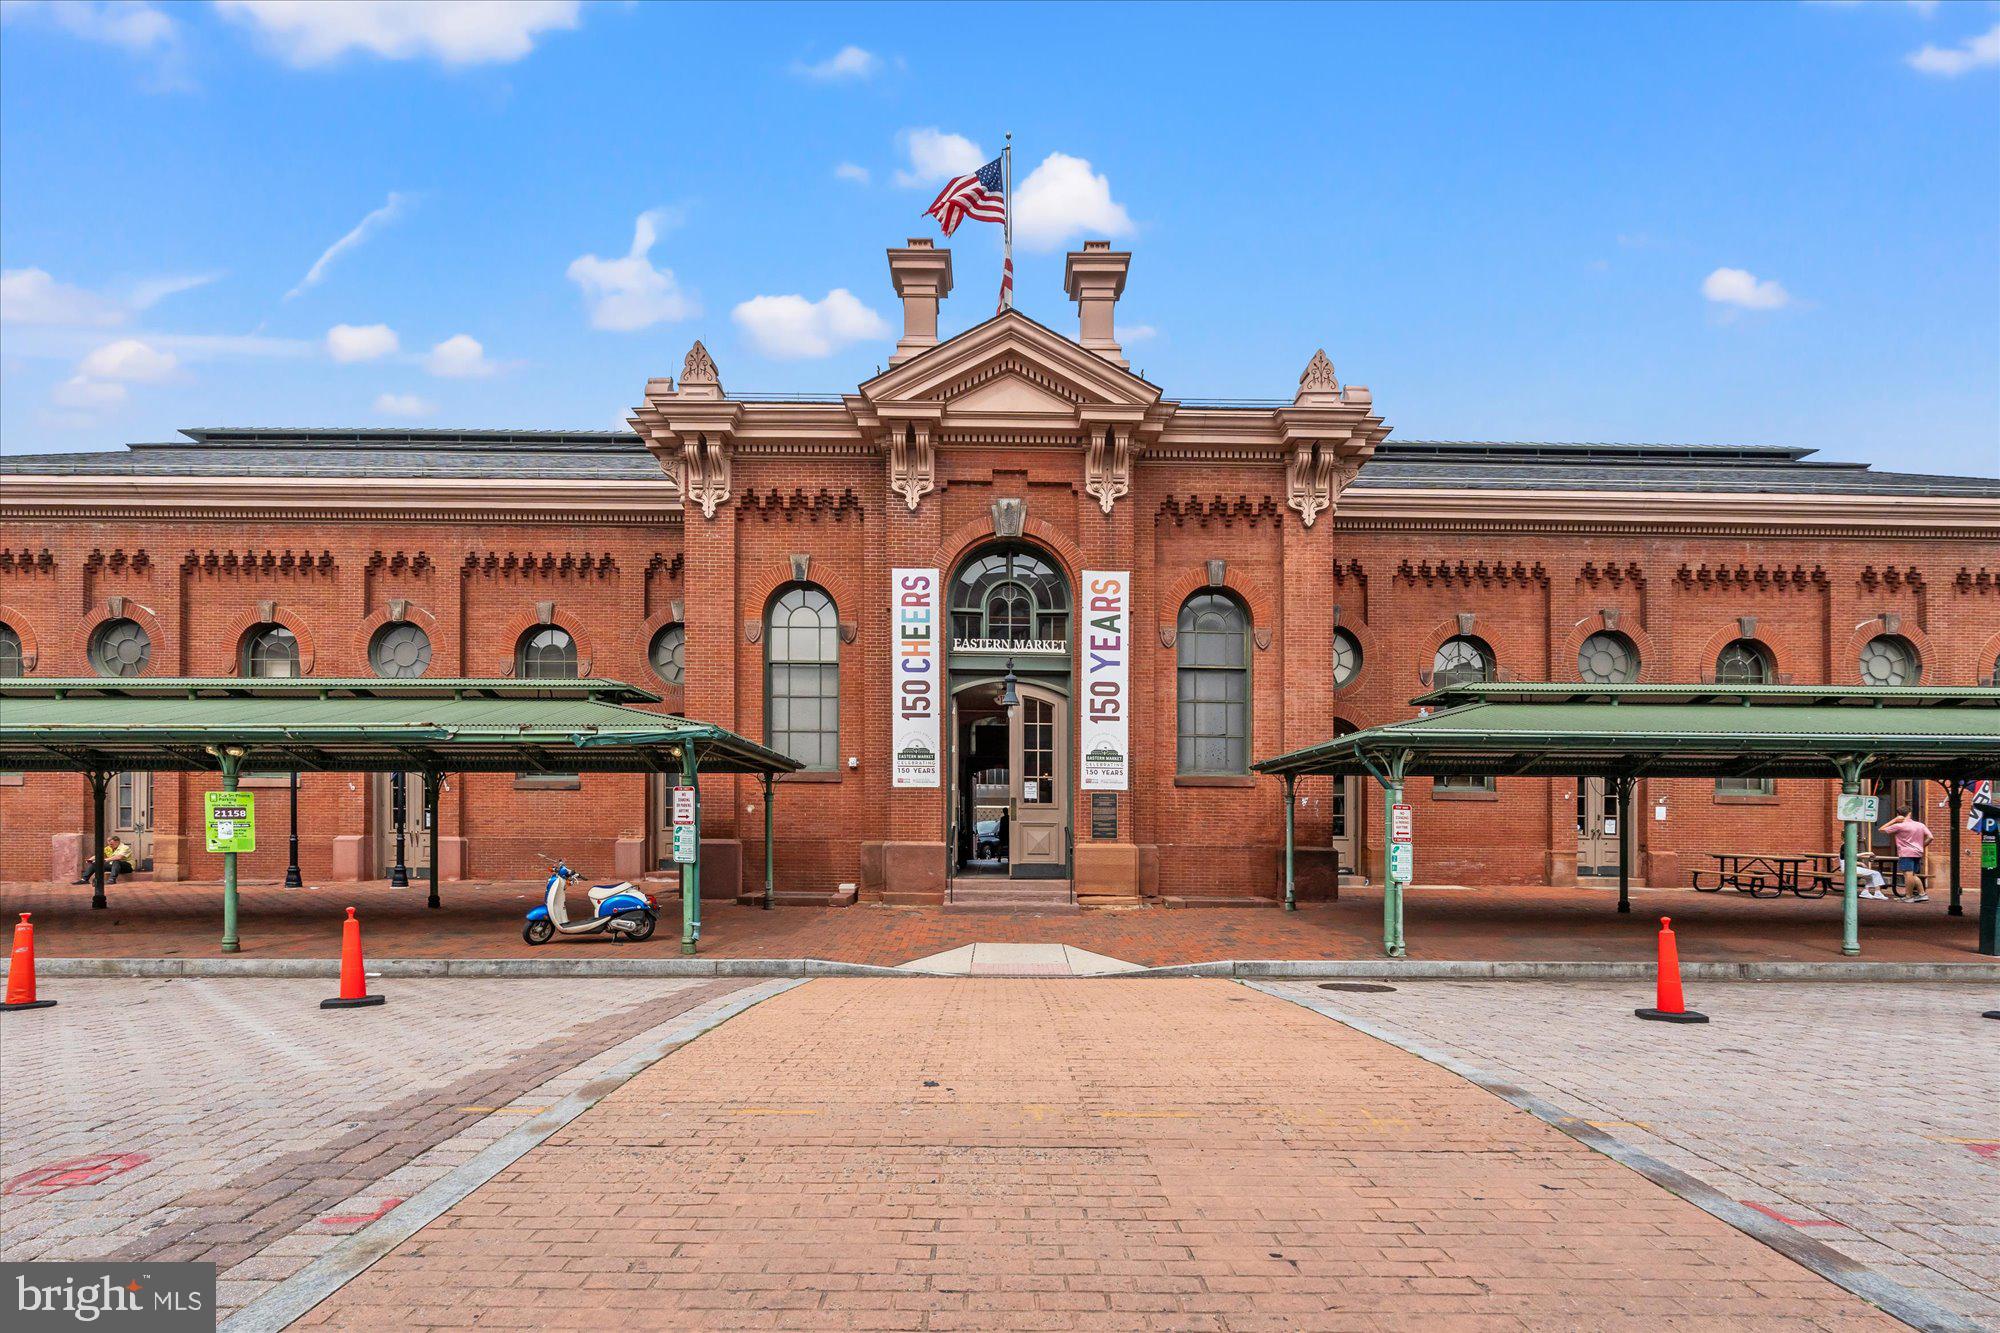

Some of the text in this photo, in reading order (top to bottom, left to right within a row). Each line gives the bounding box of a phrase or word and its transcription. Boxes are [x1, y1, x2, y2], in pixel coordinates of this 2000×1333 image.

[901, 576, 930, 673] CHEERS
[954, 638, 1067, 650] EASTERN MARKET
[1090, 580, 1121, 674] YEARS
[902, 680, 930, 720] 150
[1090, 681, 1120, 724] 150
[1868, 800, 1874, 808] 2
[1986, 818, 1995, 831] P
